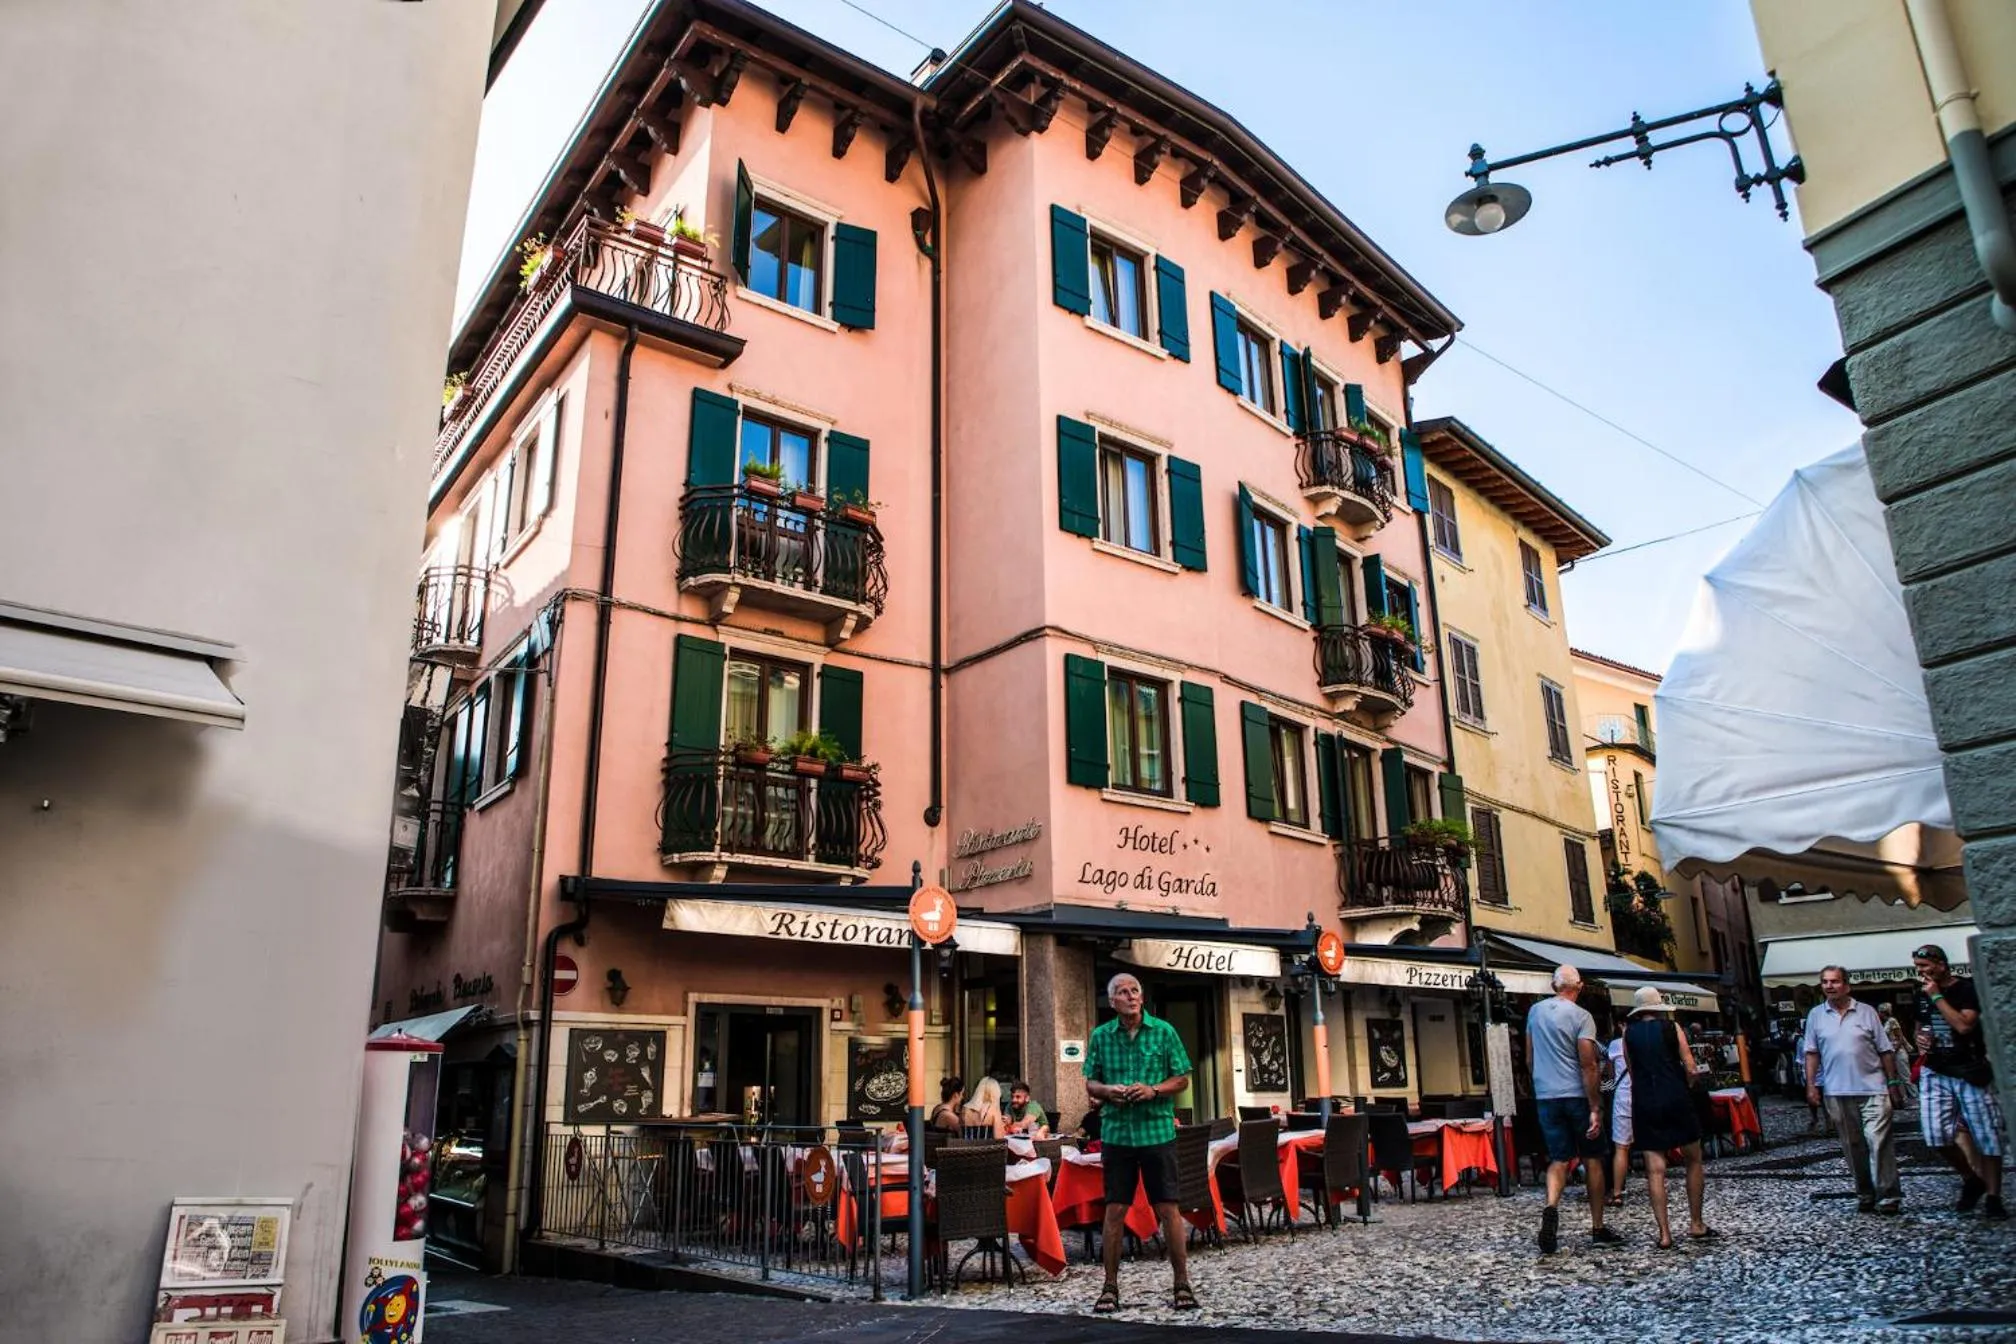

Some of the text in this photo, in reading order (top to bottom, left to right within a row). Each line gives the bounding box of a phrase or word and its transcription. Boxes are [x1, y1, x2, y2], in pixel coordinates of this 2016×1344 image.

[1607, 755, 1633, 875] RISTORANTE
[1116, 825, 1179, 855] Hotel
[1078, 862, 1218, 898] Lago di Garda
[769, 911, 913, 946] Ristoran
[1167, 948, 1238, 972] Hotel
[1406, 967, 1474, 988] Pizzeria
